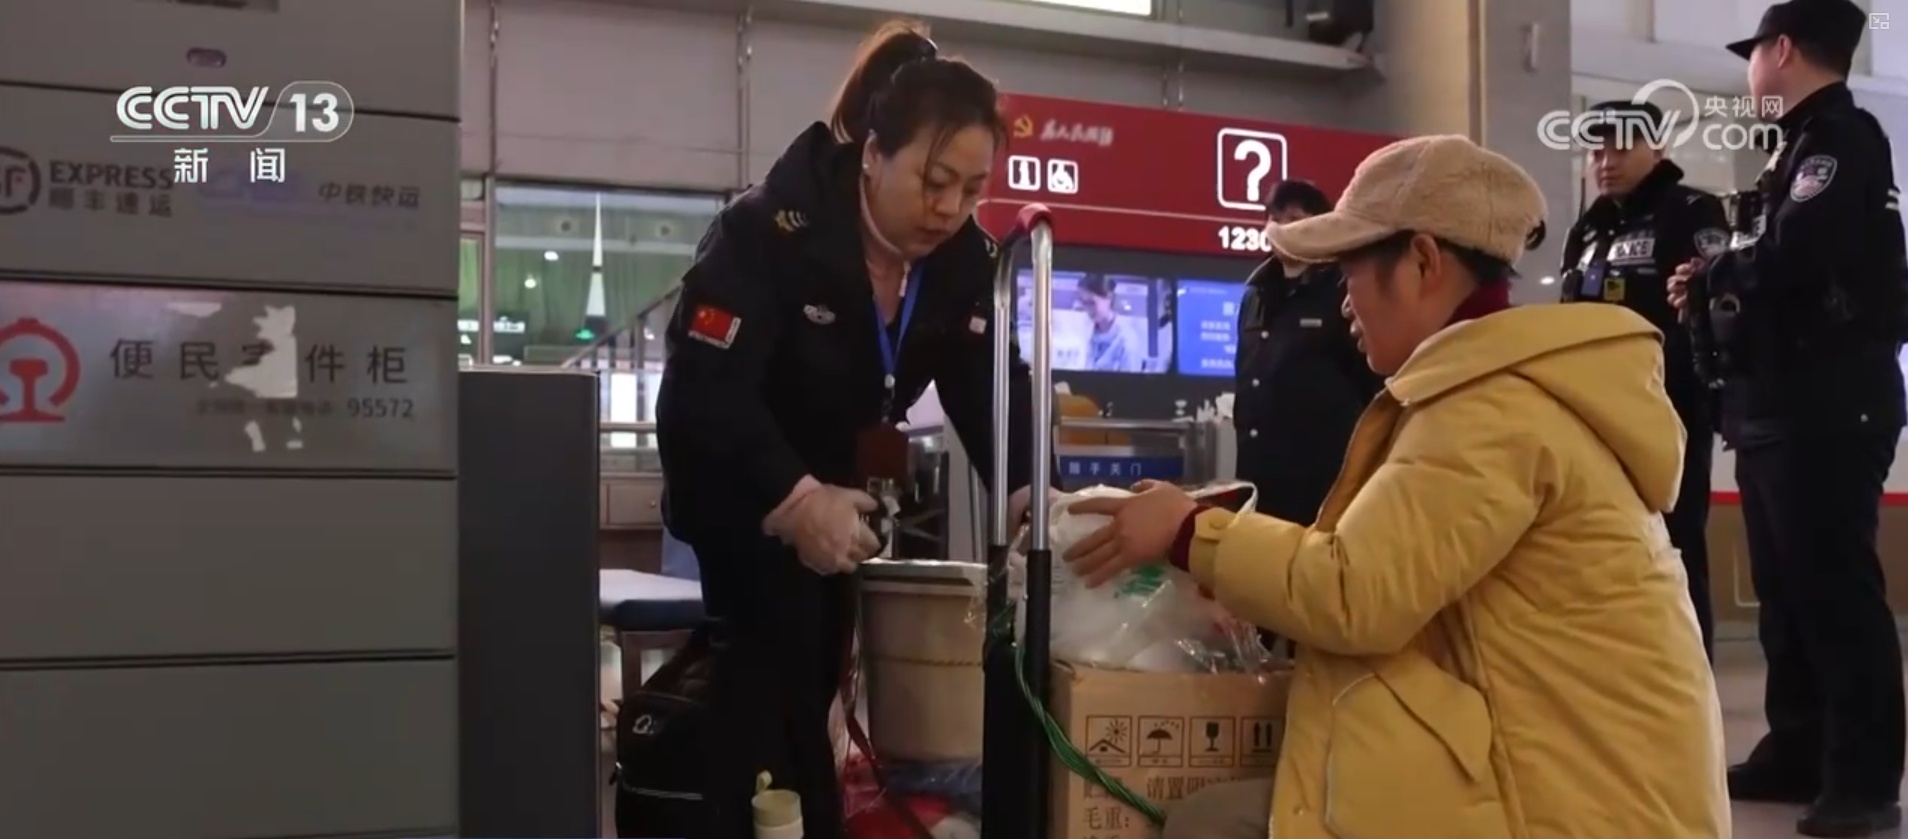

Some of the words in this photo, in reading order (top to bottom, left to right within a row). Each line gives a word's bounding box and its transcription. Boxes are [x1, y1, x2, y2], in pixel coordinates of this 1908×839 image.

[50, 160, 174, 190] EXPRESS
[318, 181, 421, 210] 中铁快运
[347, 398, 414, 418] 95572
[1068, 462, 1142, 476] 随手关门
